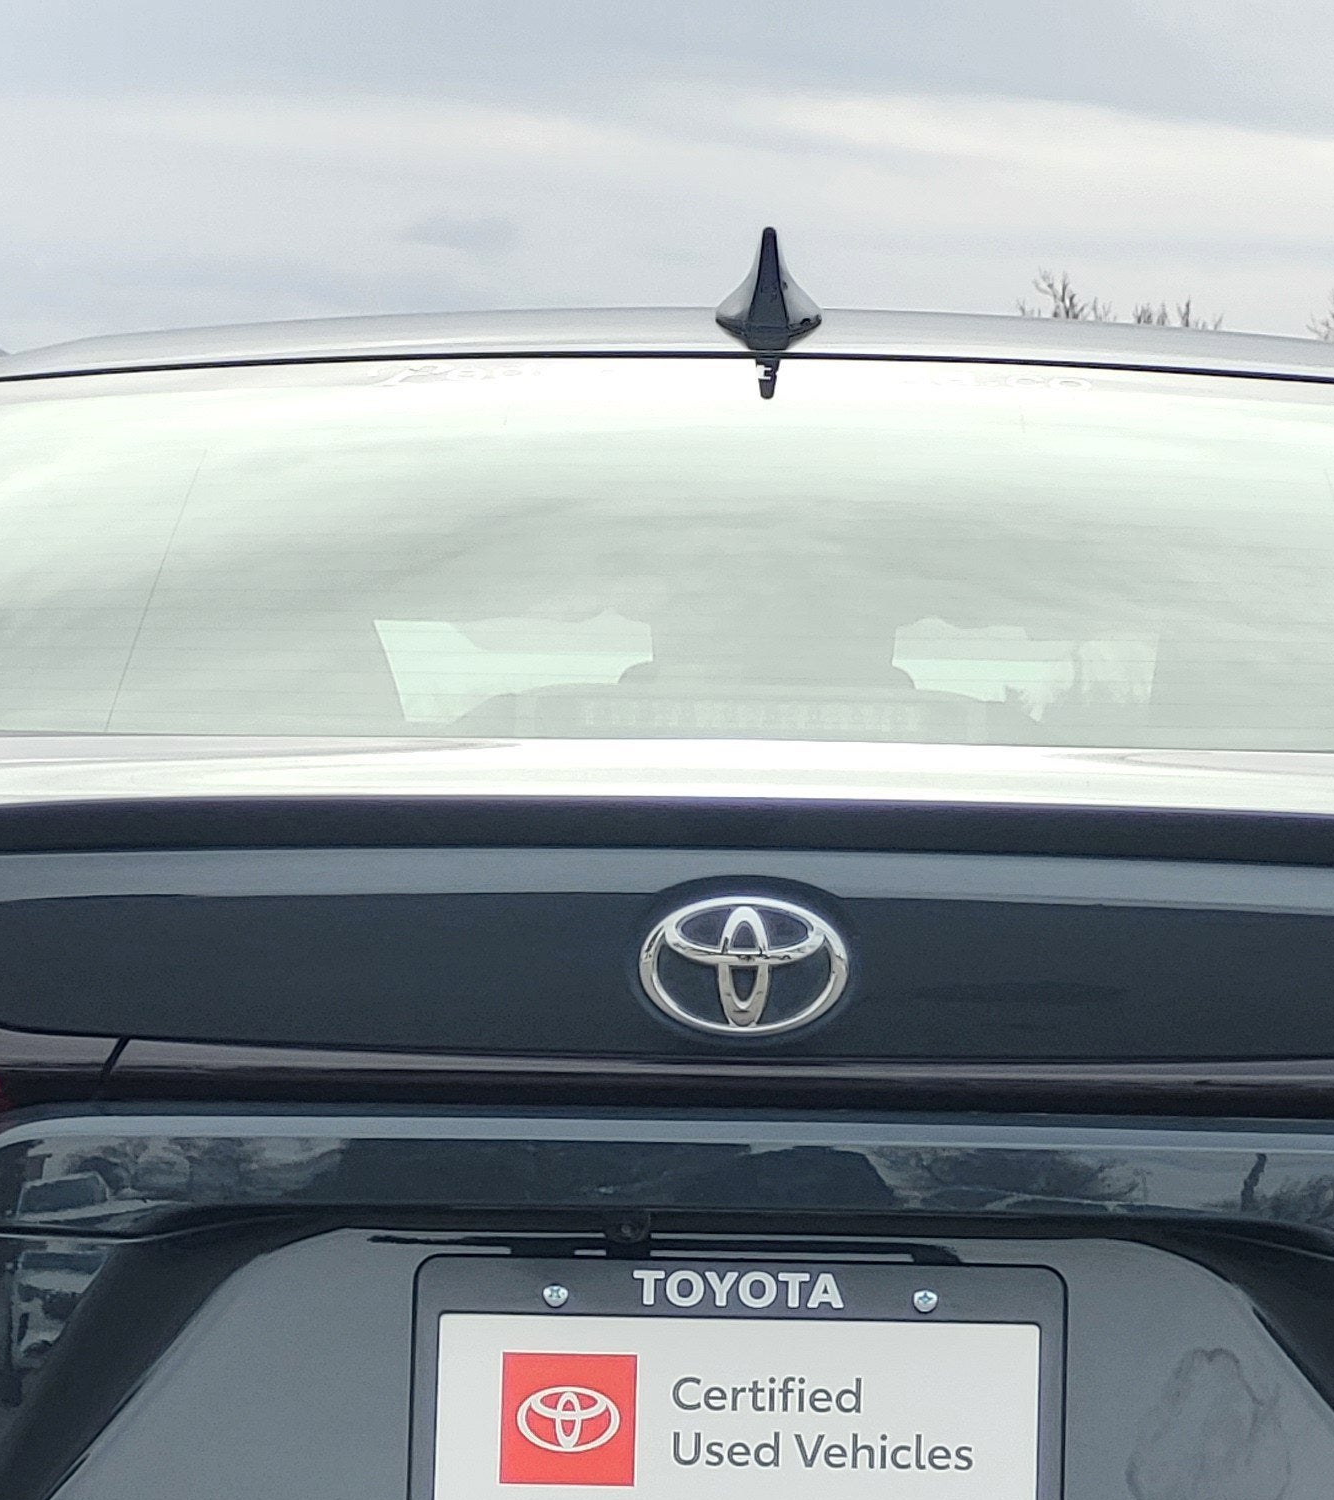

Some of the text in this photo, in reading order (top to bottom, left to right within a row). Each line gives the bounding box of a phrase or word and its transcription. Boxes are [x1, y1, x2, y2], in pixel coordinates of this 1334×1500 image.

[632, 1269, 845, 1309] TOYOTA
[671, 1376, 863, 1414] Certified
[672, 1431, 974, 1471] Used Vehicles
